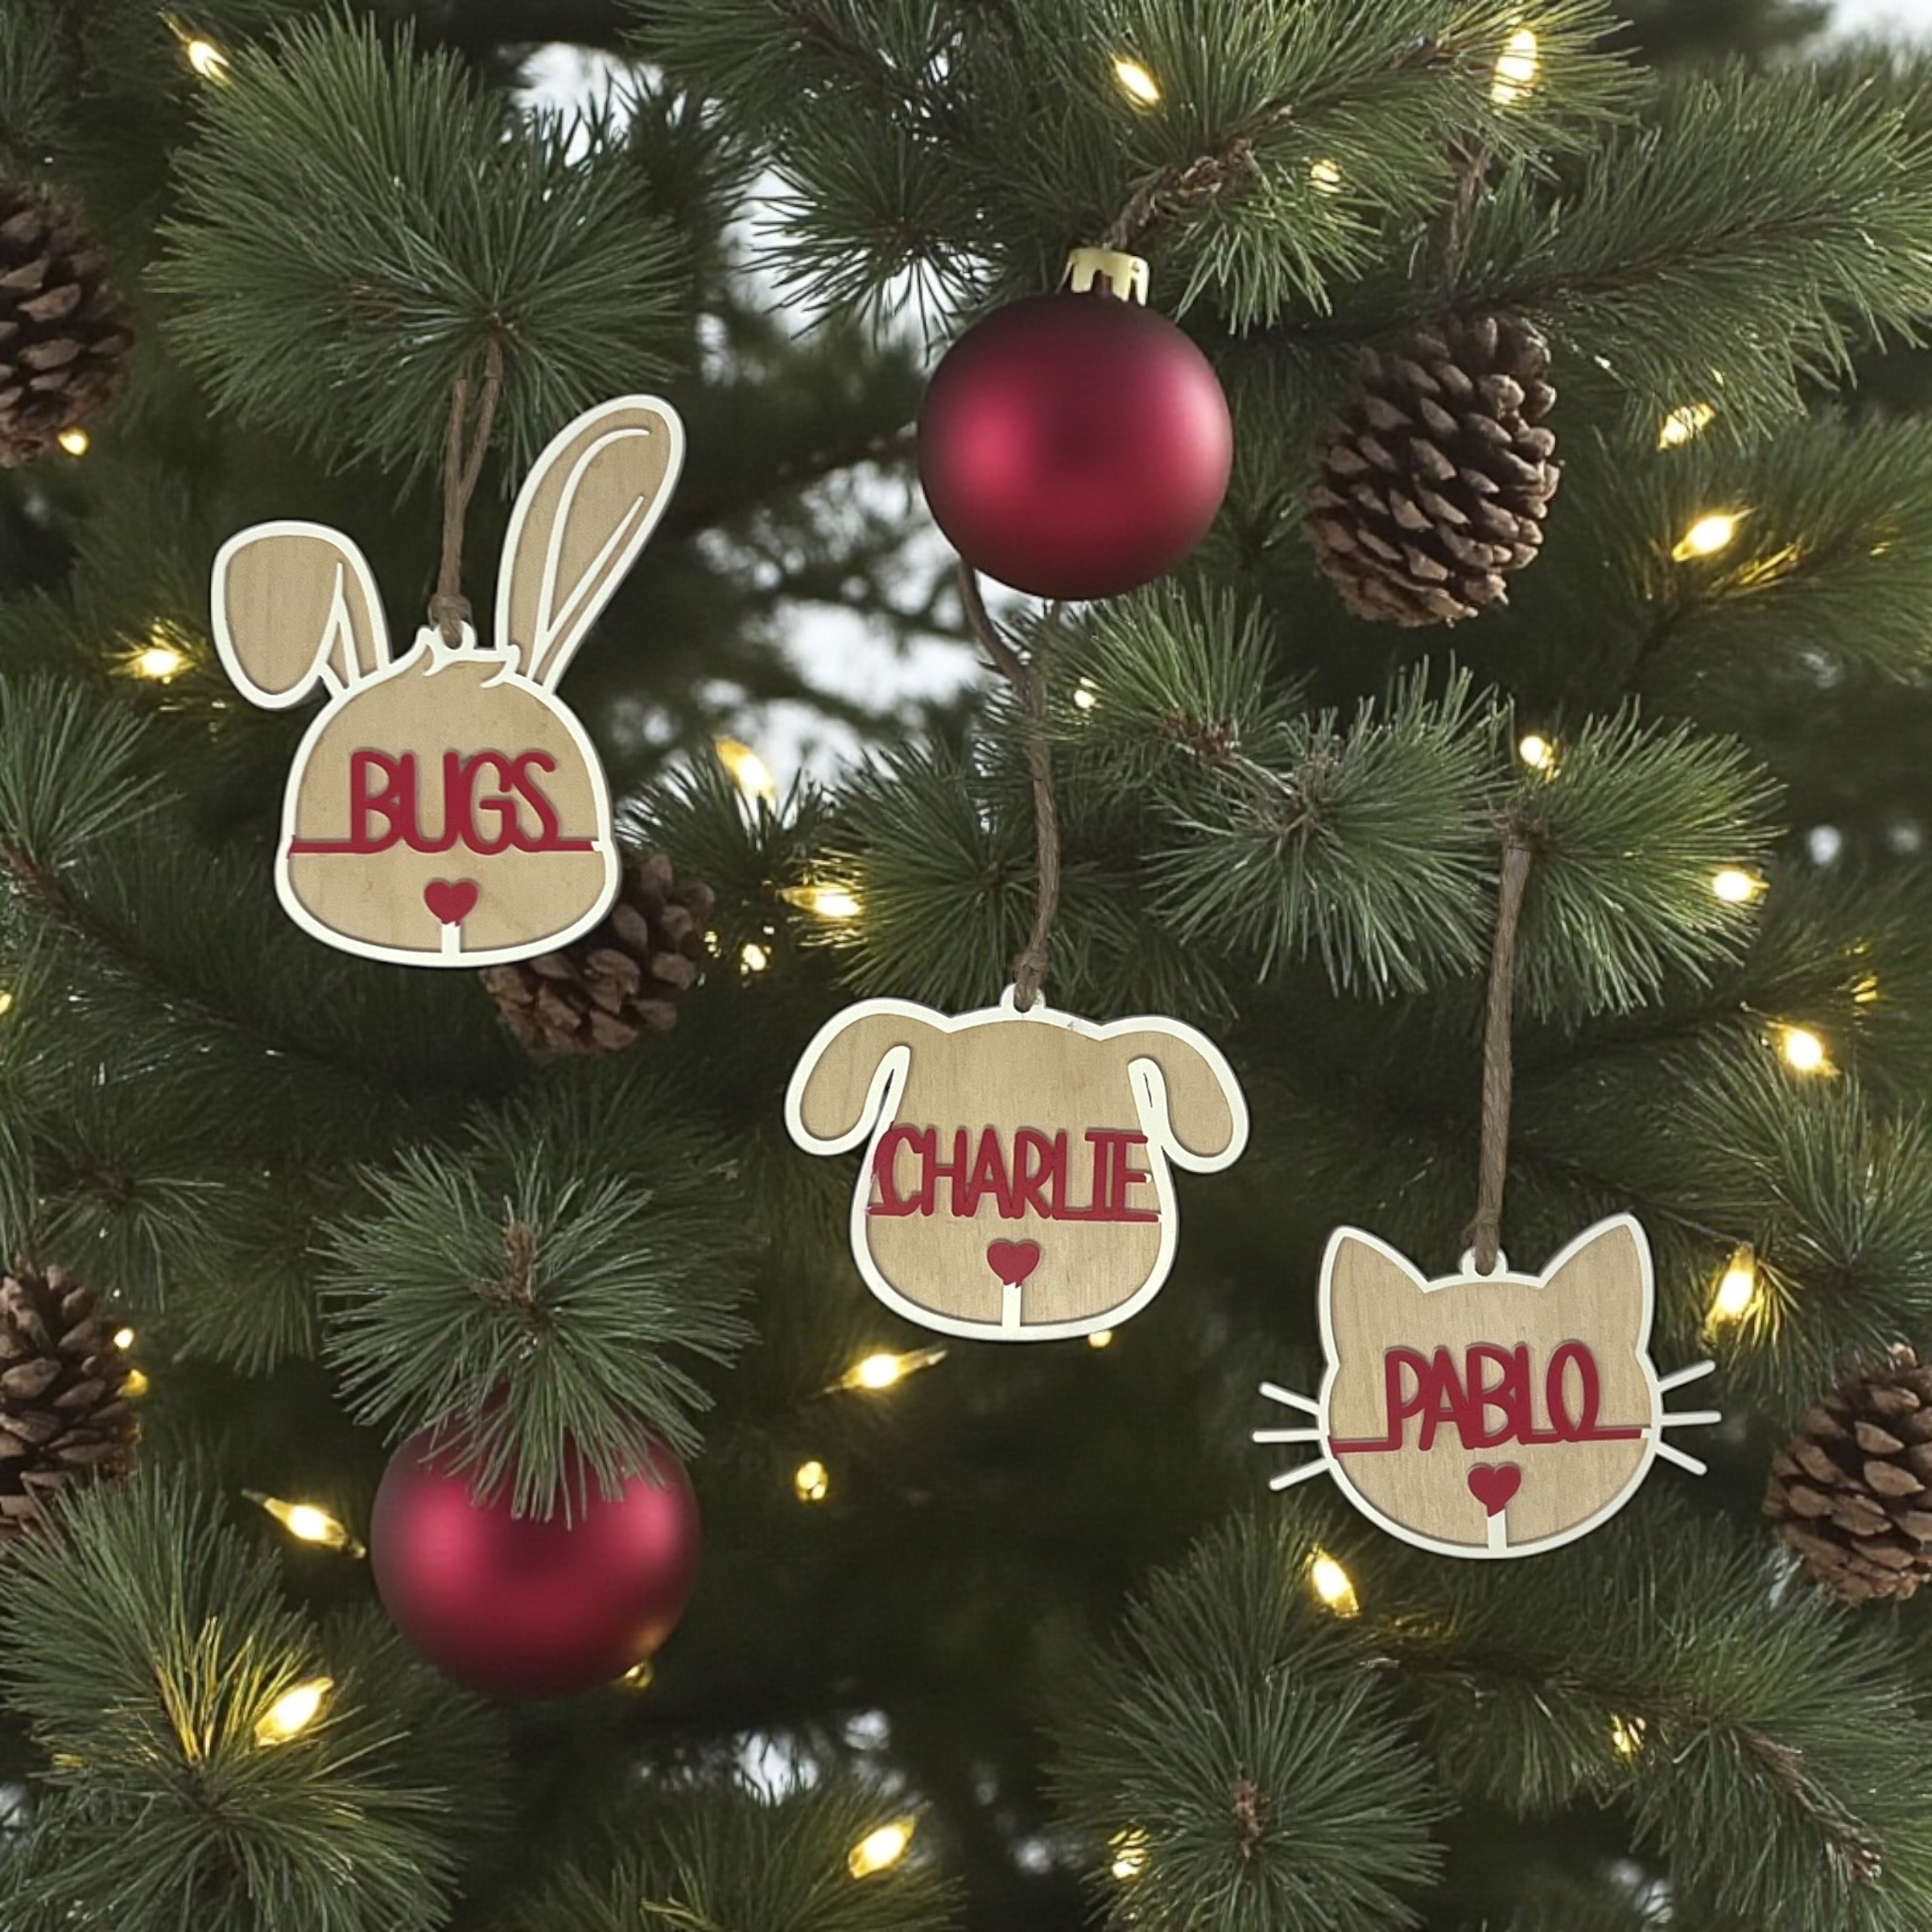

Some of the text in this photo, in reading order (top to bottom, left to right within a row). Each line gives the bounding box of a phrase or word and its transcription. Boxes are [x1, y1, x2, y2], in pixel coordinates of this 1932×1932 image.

[350, 751, 559, 855] BUGS
[871, 1126, 1159, 1222] CHARLIE
[1385, 1342, 1600, 1451] PABLO
